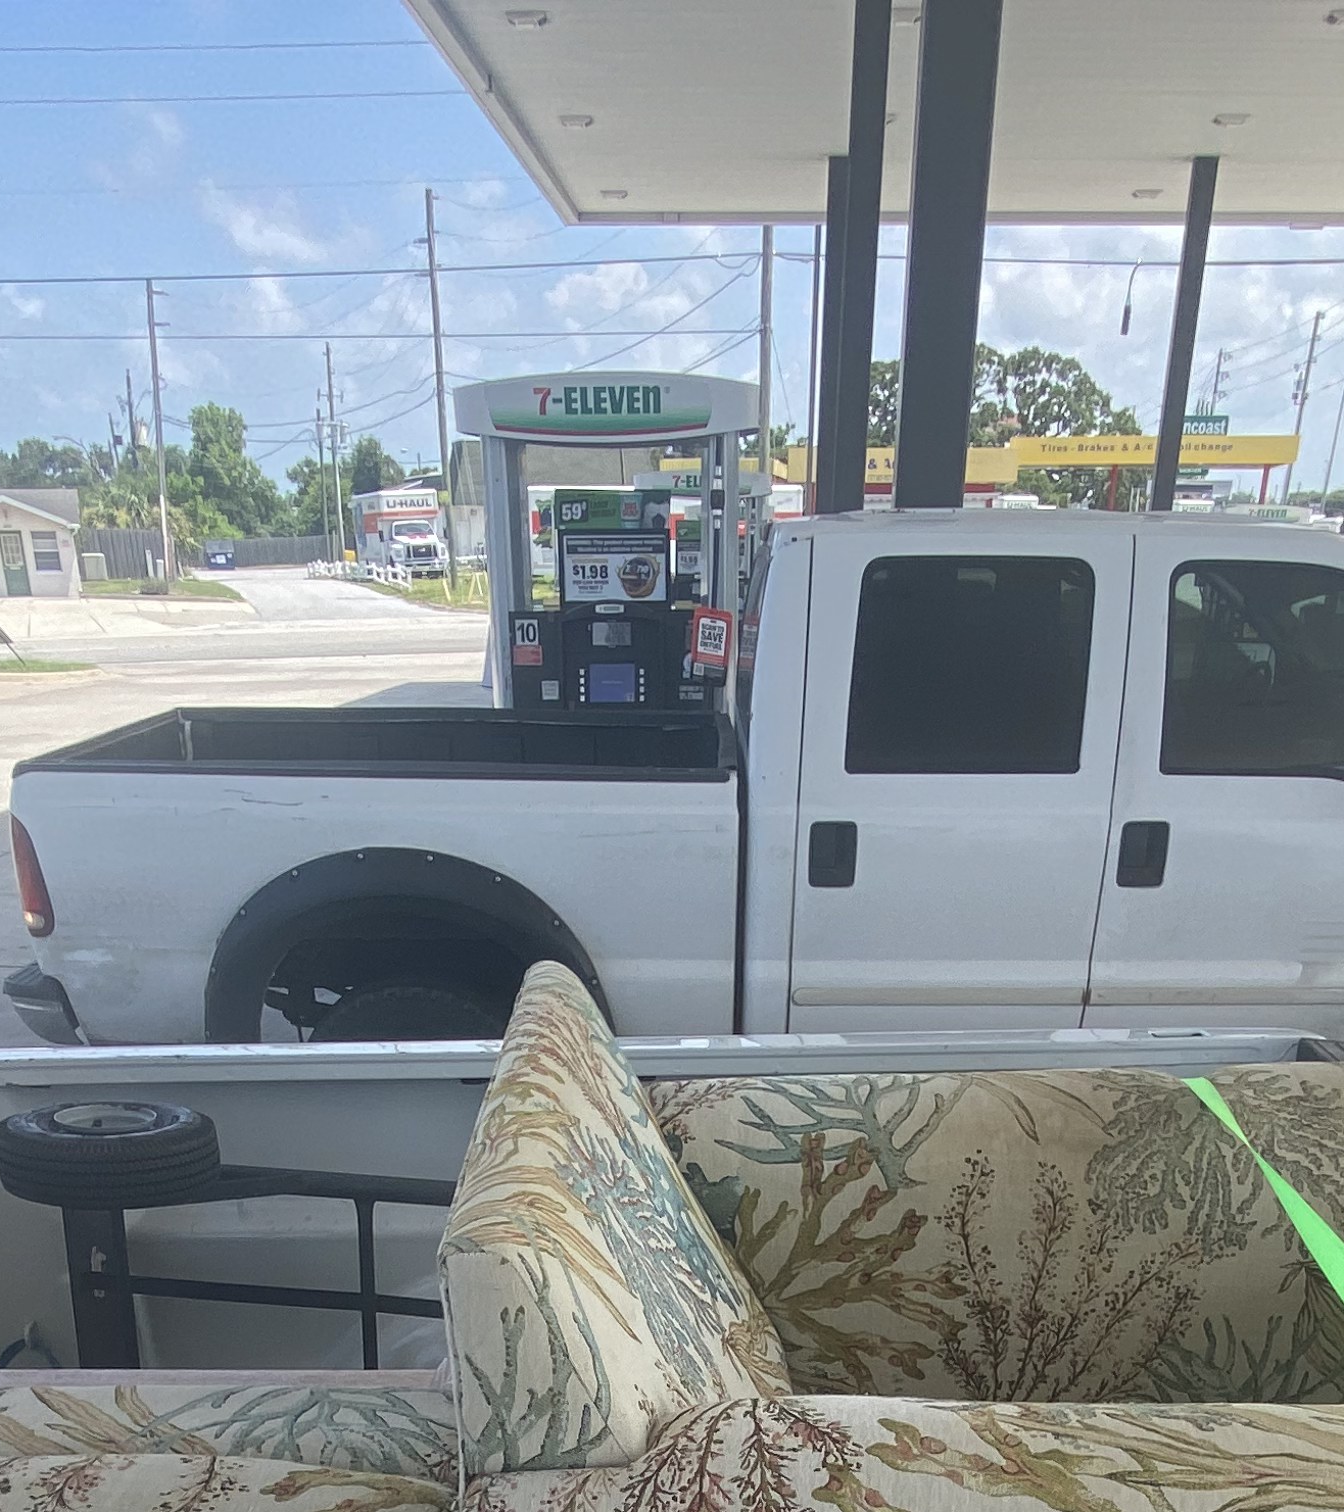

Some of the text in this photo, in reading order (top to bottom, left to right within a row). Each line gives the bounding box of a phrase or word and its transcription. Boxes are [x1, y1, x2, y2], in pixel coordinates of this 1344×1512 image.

[1182, 418, 1227, 435] ncoast
[1041, 444, 1068, 453] Tires
[1077, 443, 1115, 452] Brakes
[867, 458, 877, 470] &
[386, 498, 432, 509] U-HAUL
[572, 564, 609, 580] $1.98
[516, 622, 537, 644] 10
[700, 630, 724, 644] SAVE
